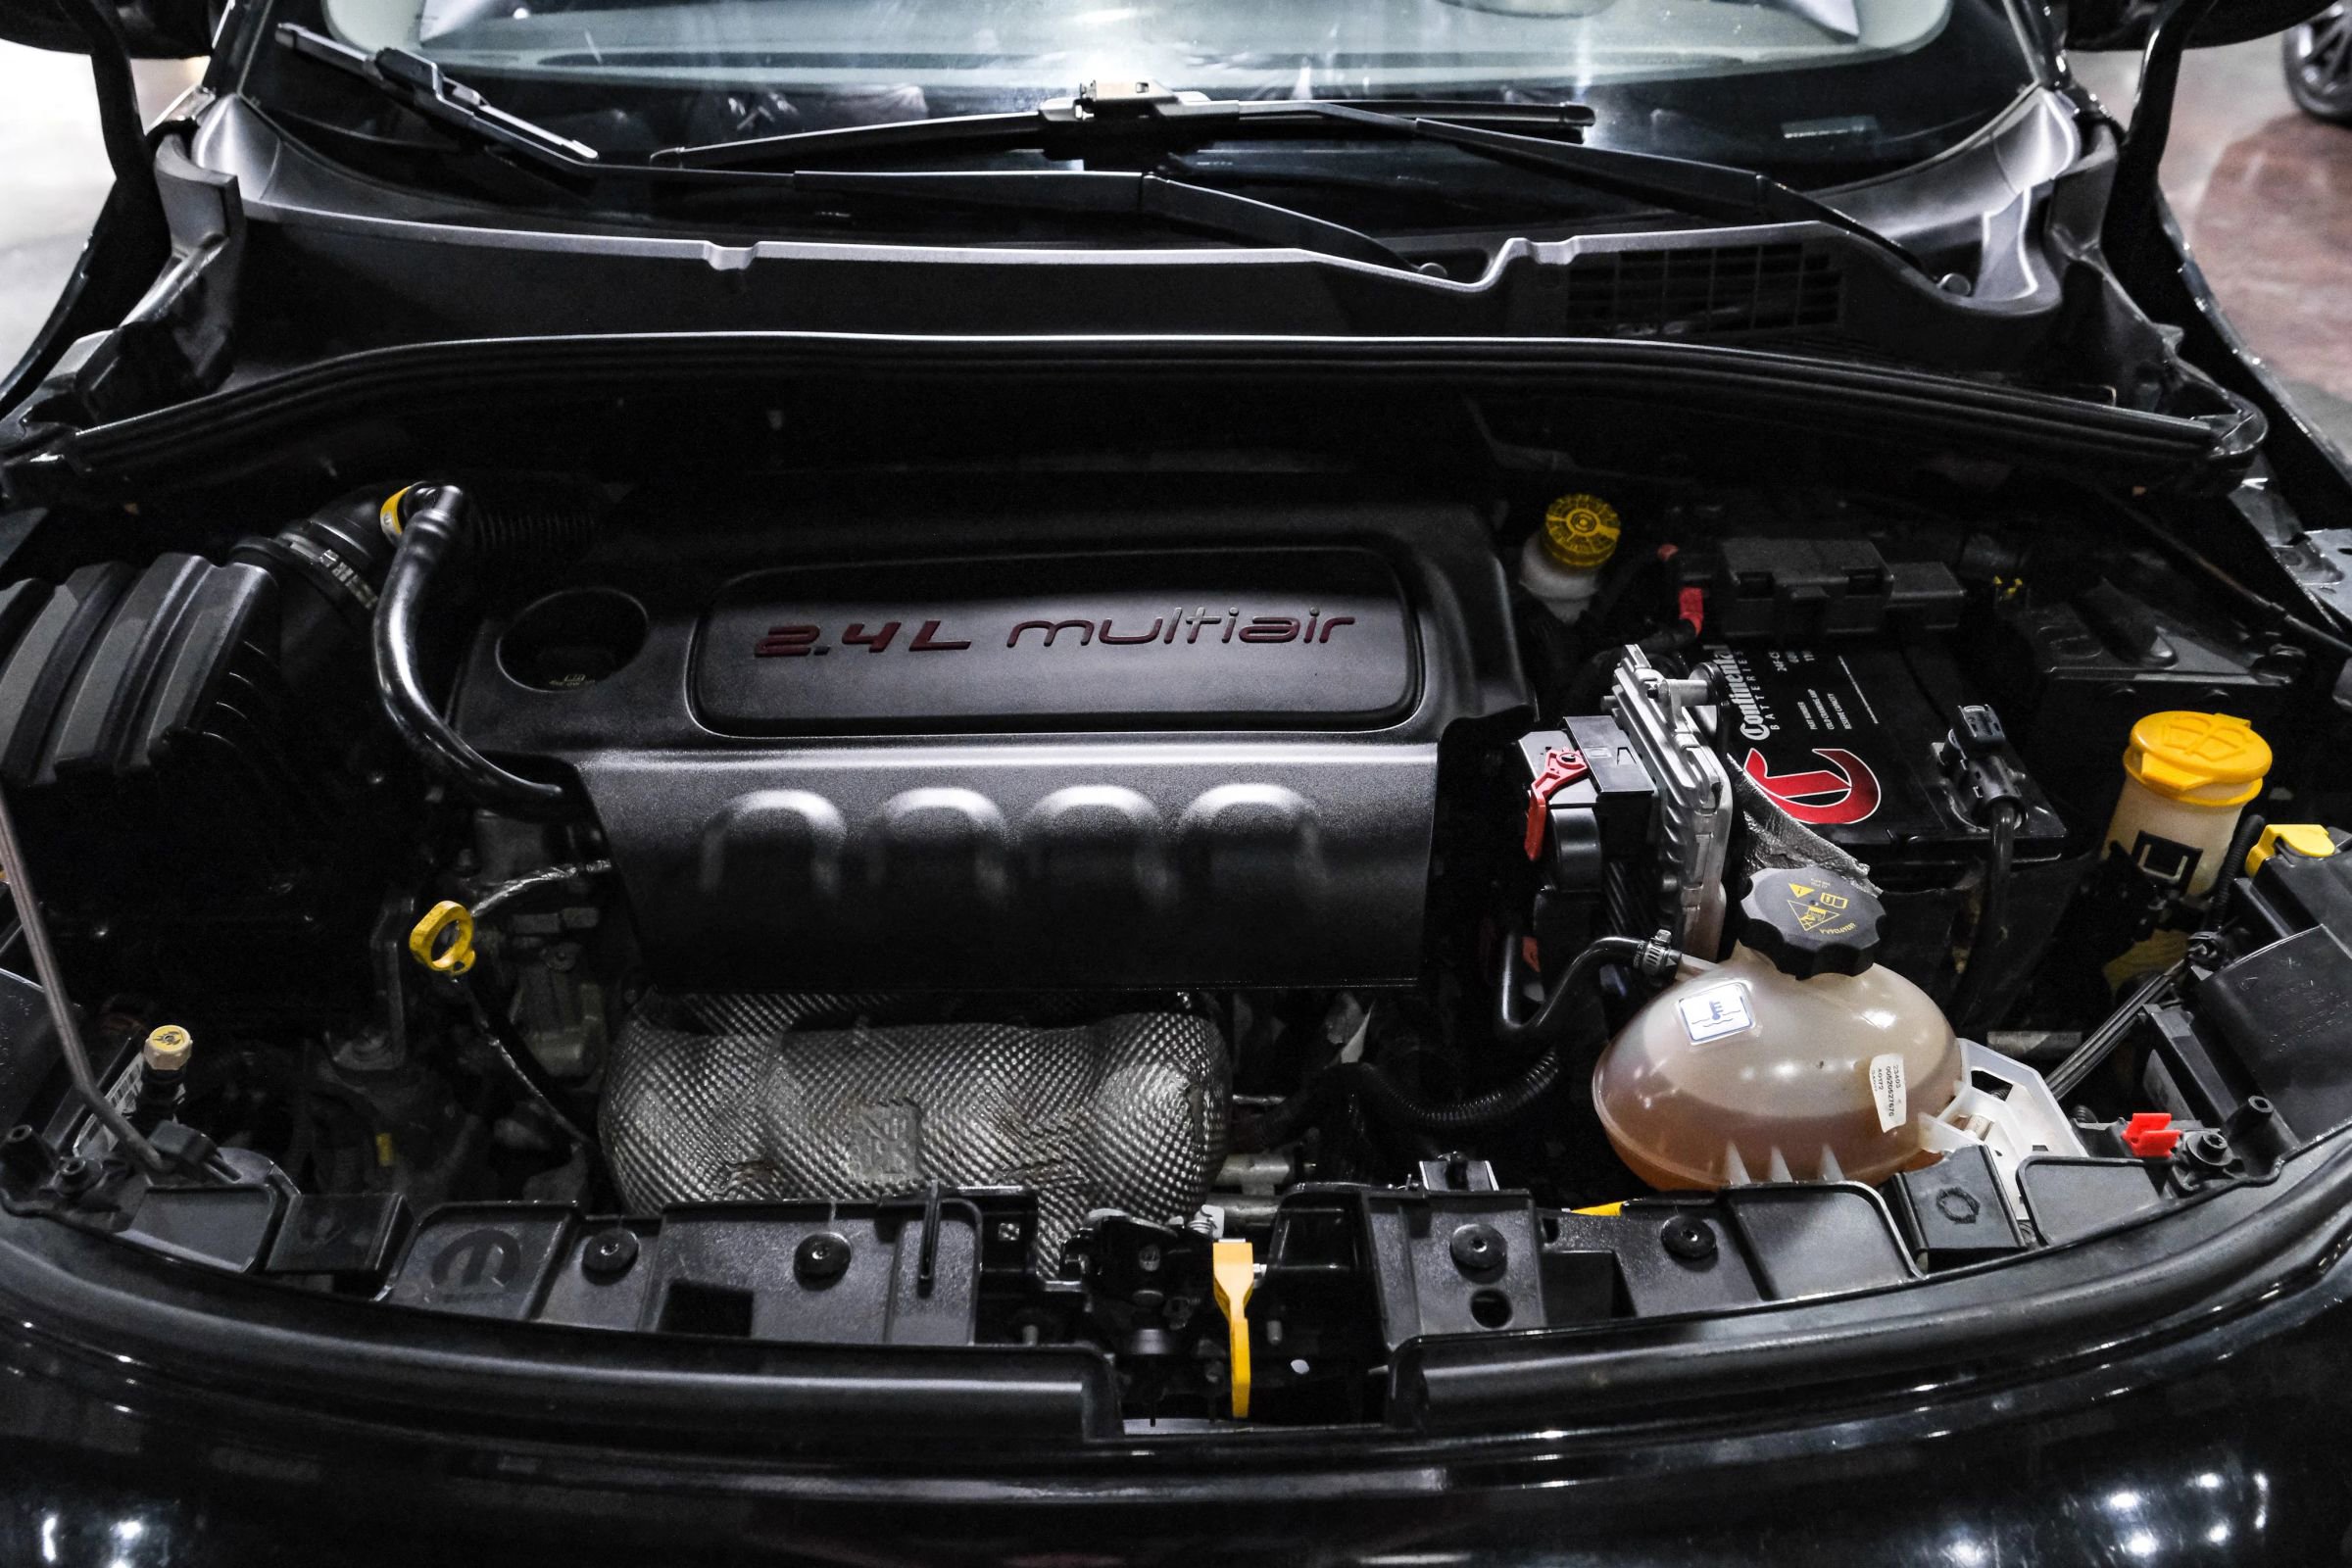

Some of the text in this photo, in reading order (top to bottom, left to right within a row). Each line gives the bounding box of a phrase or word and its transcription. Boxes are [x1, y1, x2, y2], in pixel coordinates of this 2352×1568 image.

[754, 606, 1356, 657] 2.4L multiair
[1703, 644, 1771, 740] Continental
[1734, 651, 1781, 730] BATTERIES
